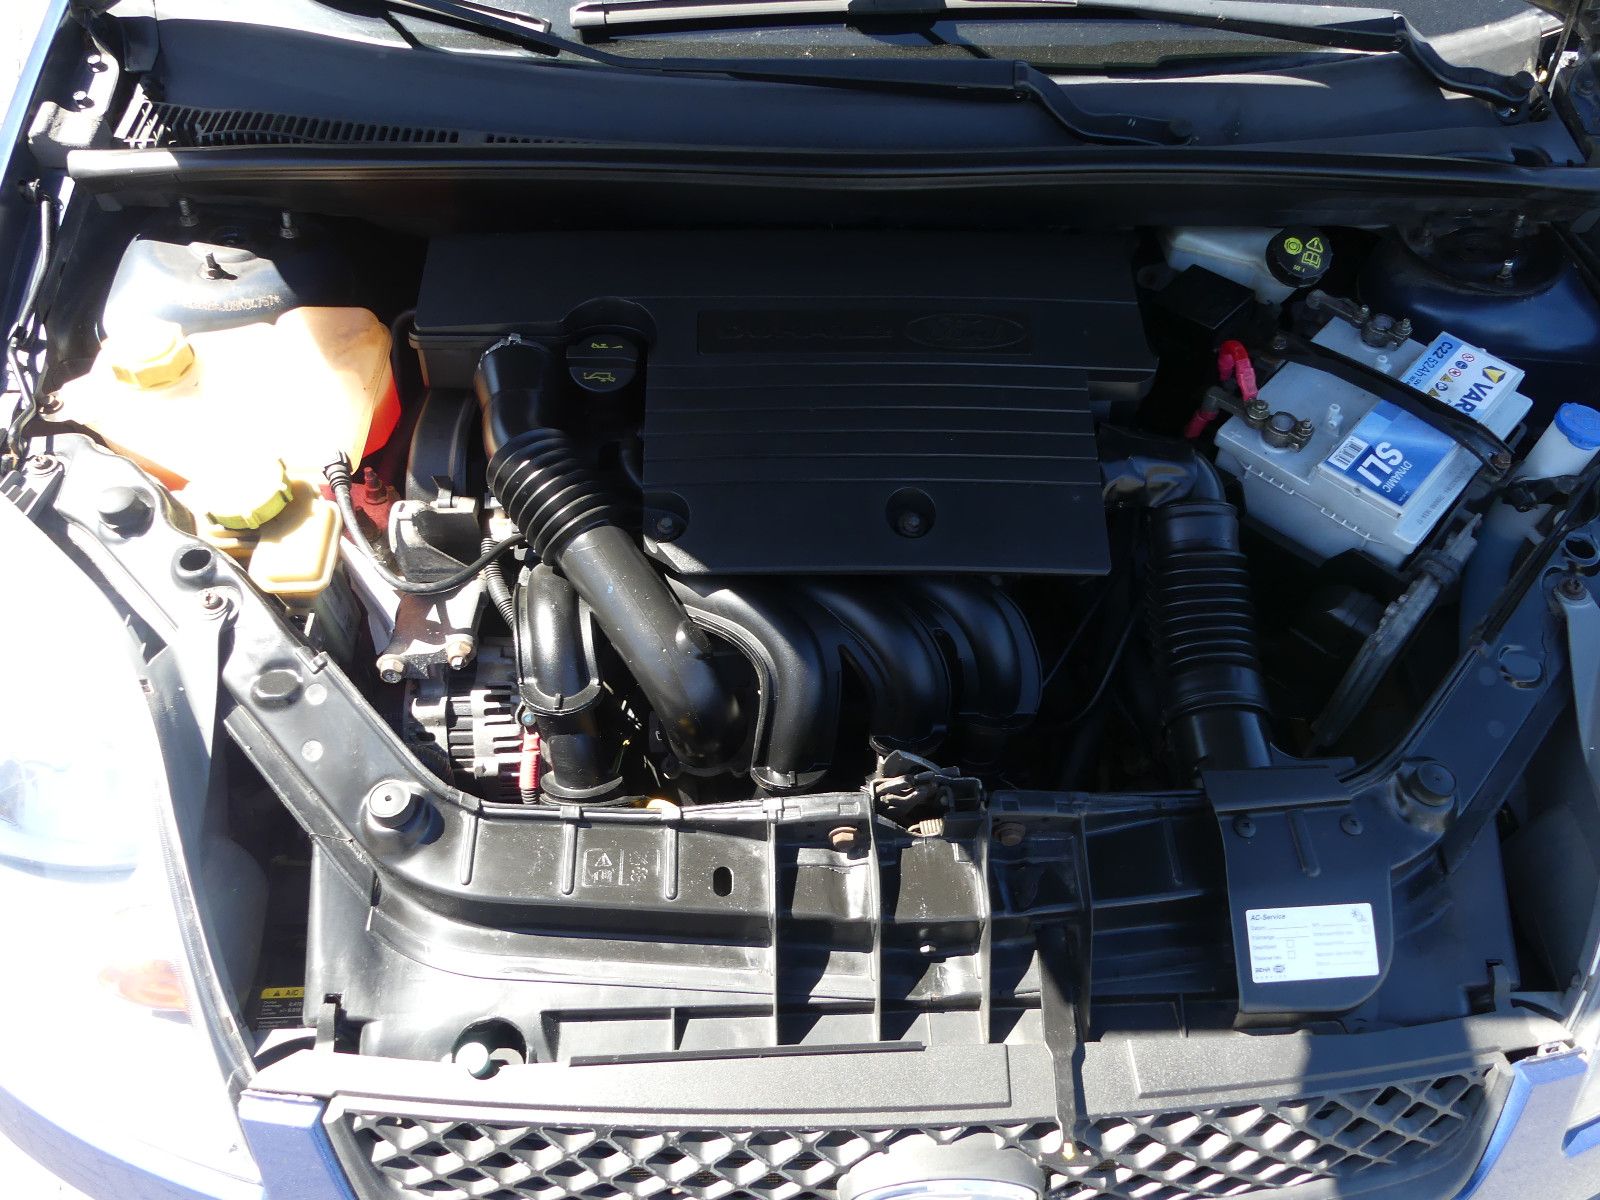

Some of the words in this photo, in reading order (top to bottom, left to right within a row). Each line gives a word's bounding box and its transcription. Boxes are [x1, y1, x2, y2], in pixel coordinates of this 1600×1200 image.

[1432, 342, 1453, 359] C22
[1454, 382, 1494, 415] VAR
[1357, 442, 1403, 487] SLI
[1382, 460, 1413, 493] DYNAMIC
